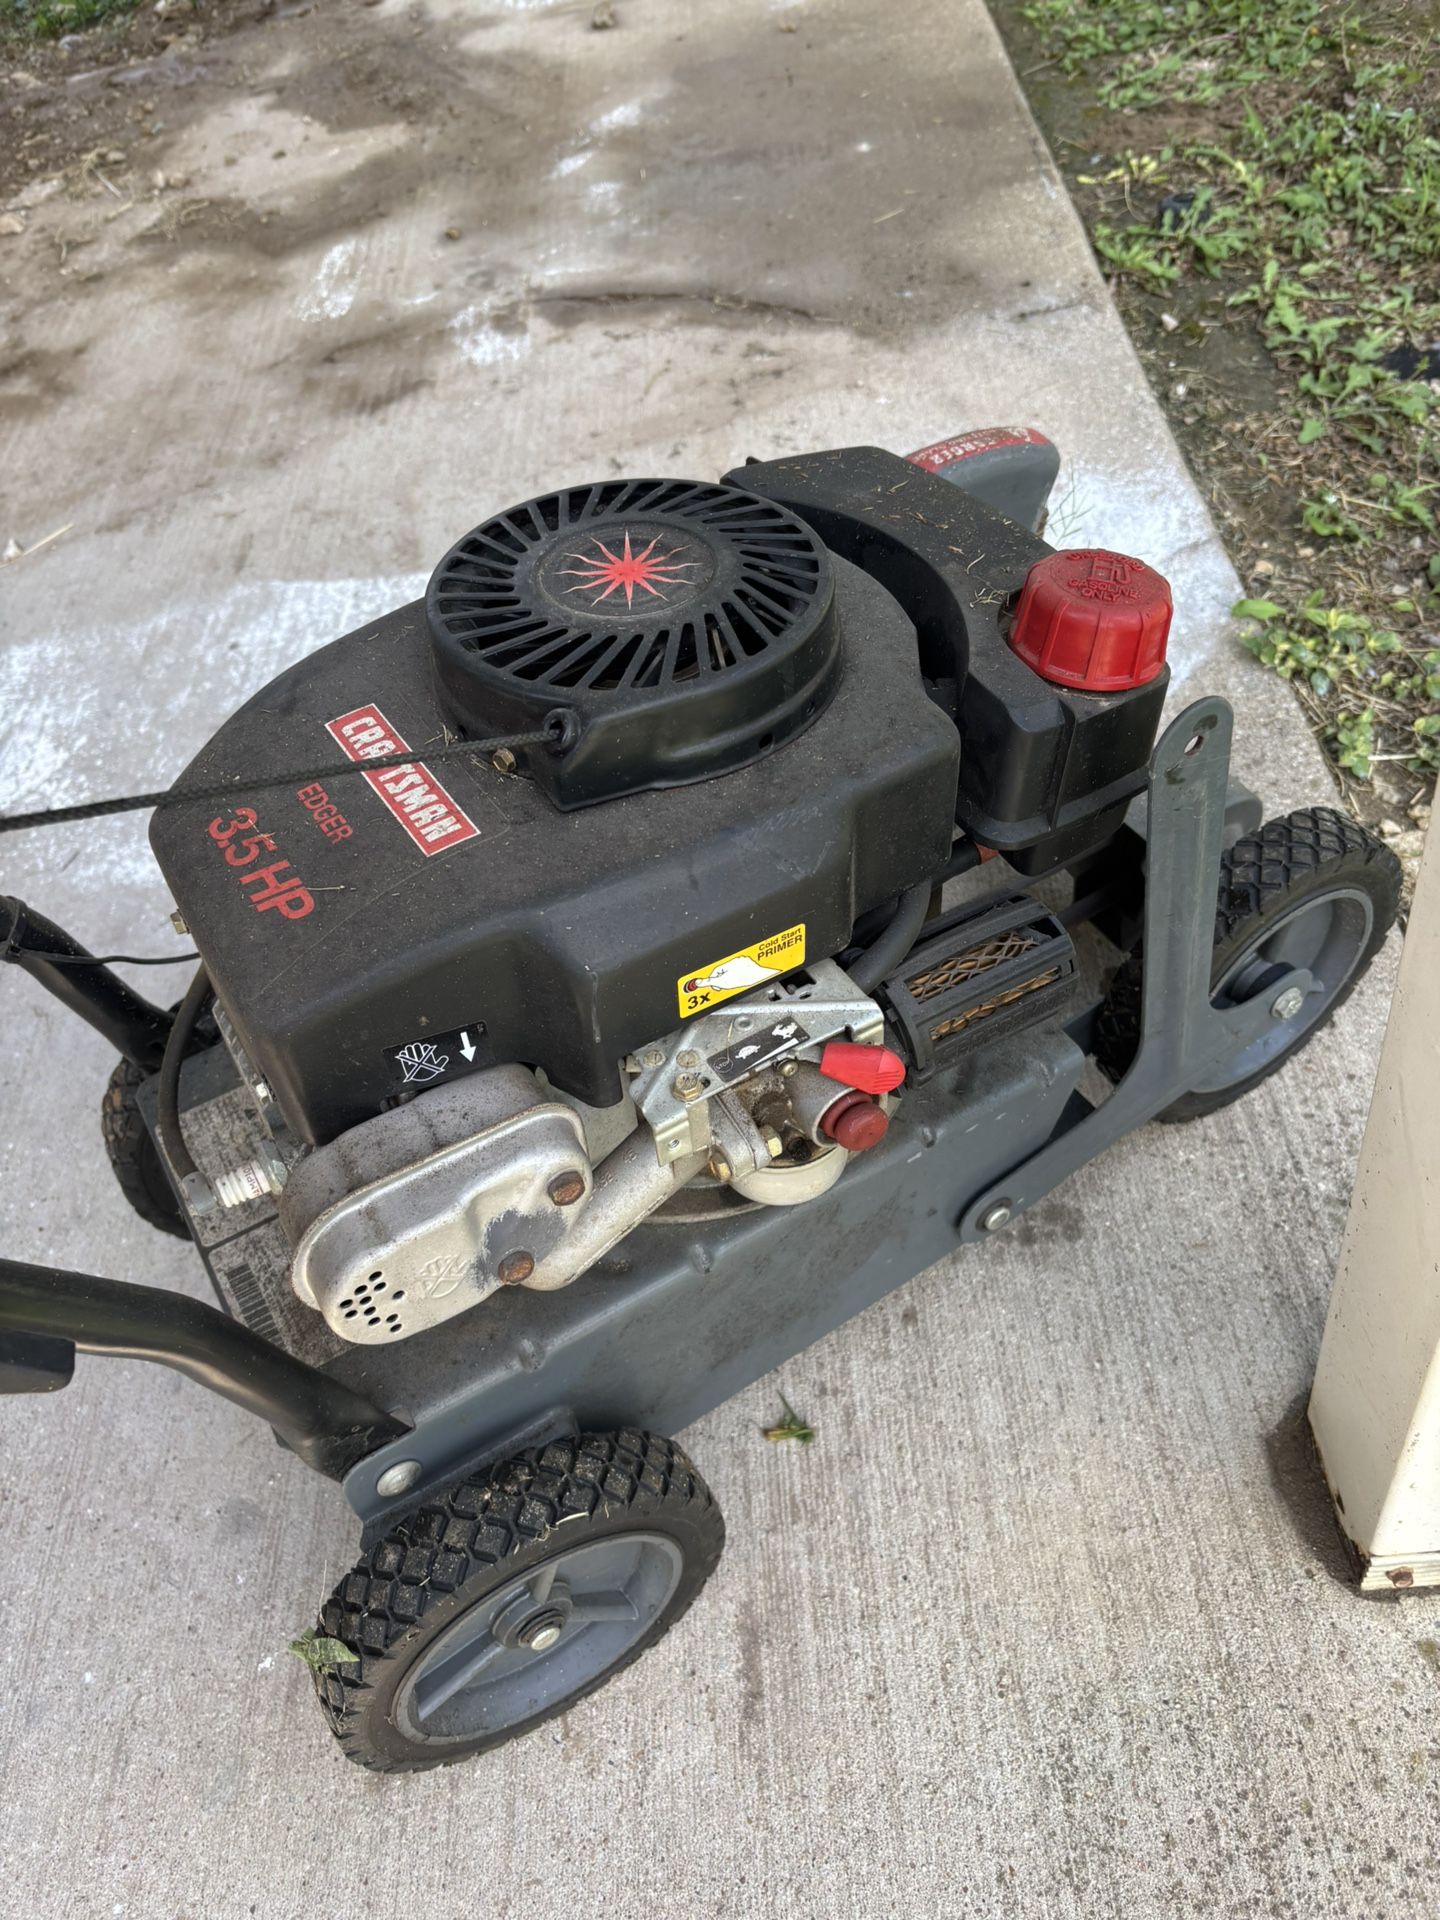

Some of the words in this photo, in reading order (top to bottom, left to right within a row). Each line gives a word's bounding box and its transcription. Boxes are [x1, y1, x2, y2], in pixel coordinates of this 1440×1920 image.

[340, 716, 463, 843] CRATSMAN
[208, 807, 278, 867] 3.5
[296, 782, 354, 845] EDGER
[239, 860, 316, 920] HP
[757, 934, 804, 961] PRIMER
[758, 936, 779, 952] Cold
[781, 927, 802, 943] Start
[687, 992, 711, 1010] 3x
